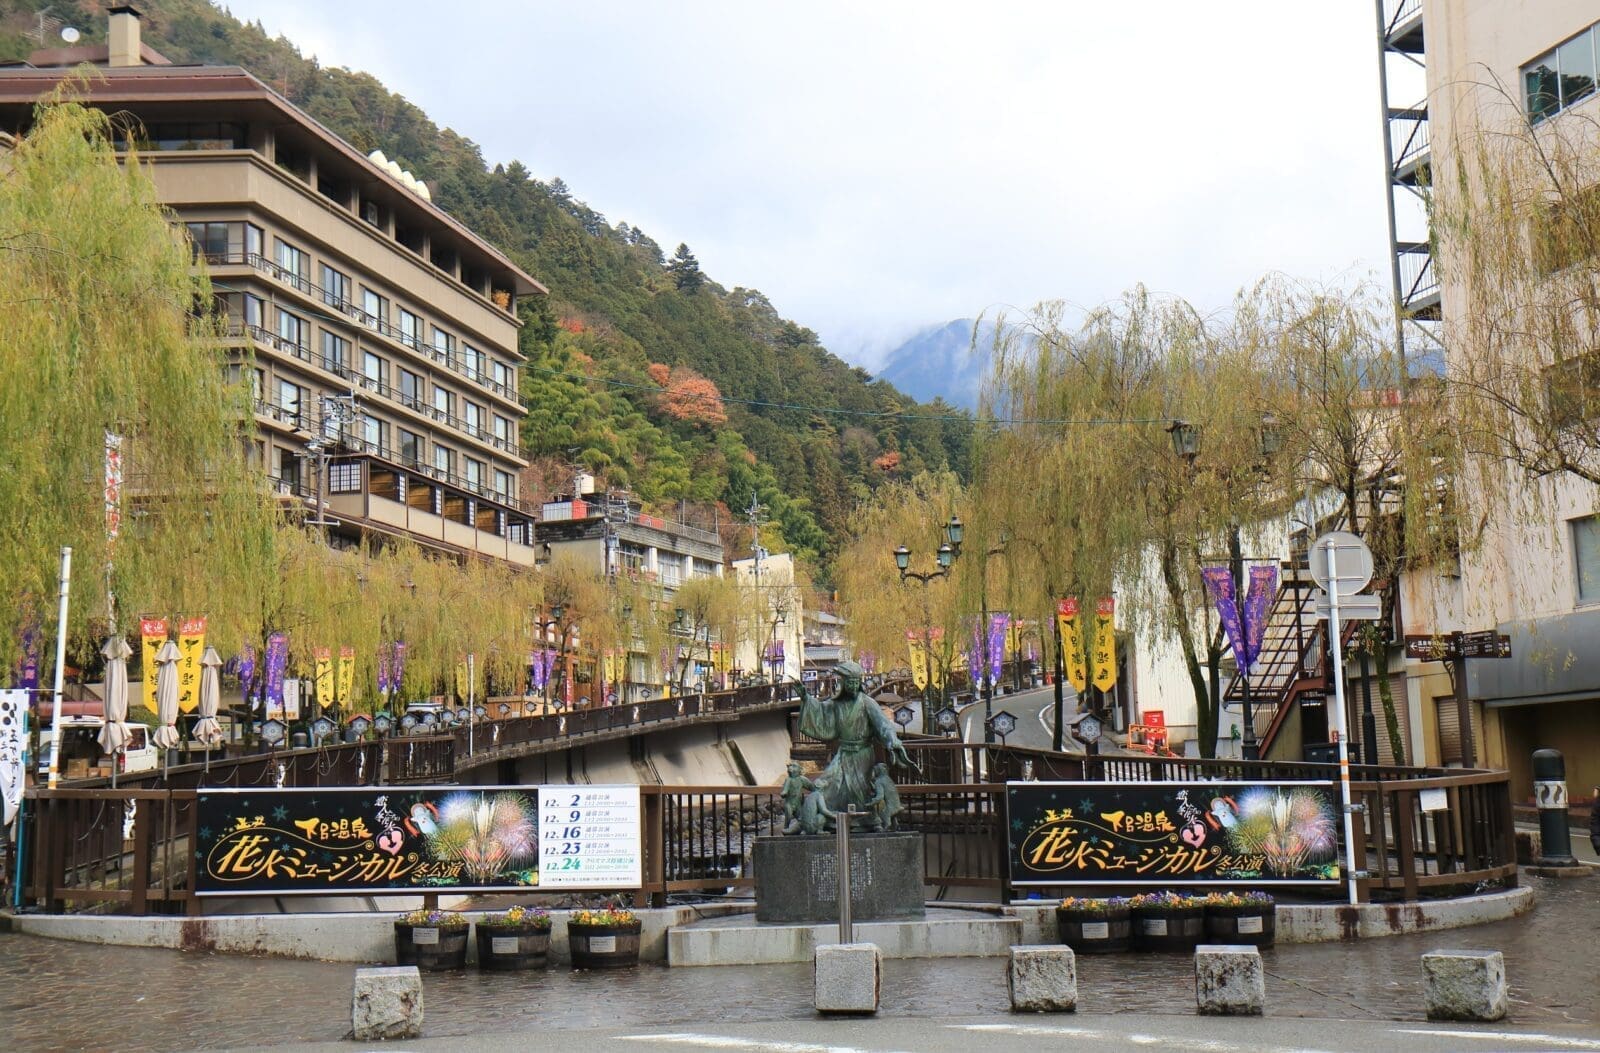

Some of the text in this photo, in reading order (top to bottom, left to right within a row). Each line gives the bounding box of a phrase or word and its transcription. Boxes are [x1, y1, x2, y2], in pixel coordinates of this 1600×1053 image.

[570, 794, 581, 807] 2
[294, 816, 373, 841] 下呂温泉
[569, 810, 581, 823] 9
[1100, 810, 1177, 833] 下呂温泉
[216, 834, 465, 884] 花火ミュージカル 冬公演
[1029, 826, 1267, 875] 花火ミュージカル 冬公演
